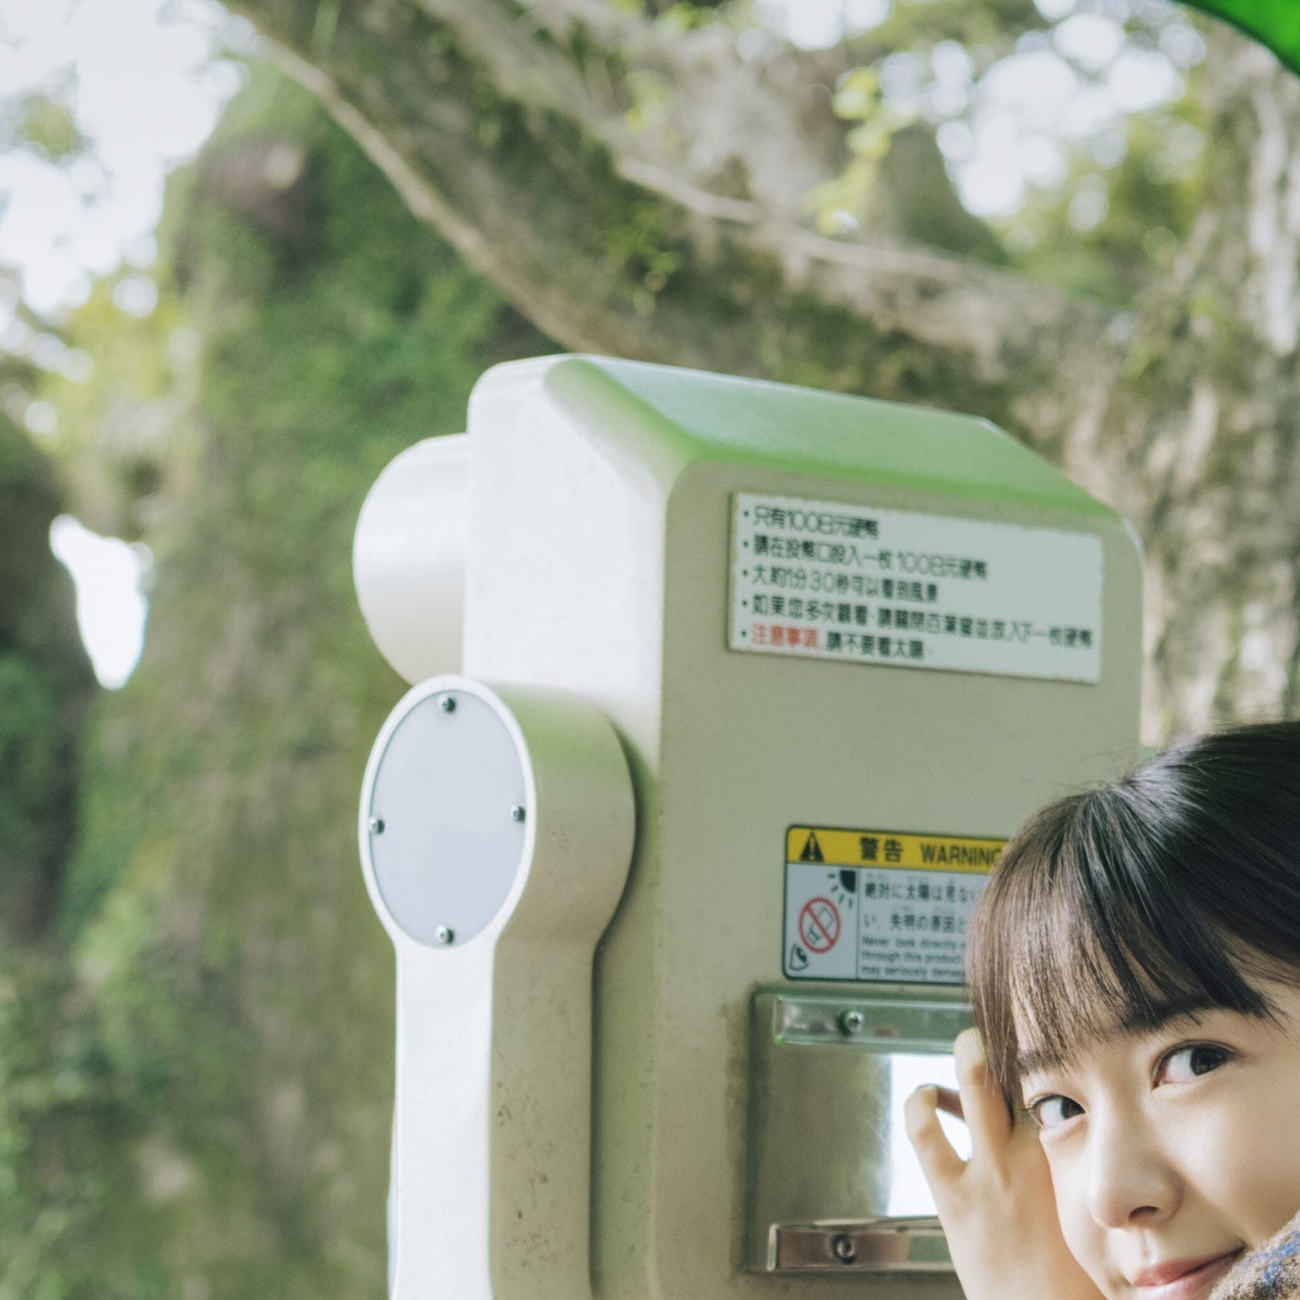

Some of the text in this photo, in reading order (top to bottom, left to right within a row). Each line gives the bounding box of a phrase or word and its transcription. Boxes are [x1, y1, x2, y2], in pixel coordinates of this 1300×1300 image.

[859, 836, 904, 863] 警告
[862, 936, 889, 946] Never
[895, 938, 916, 947] look
[921, 938, 956, 951] directly
[862, 951, 900, 964] through
[904, 952, 921, 961] this
[861, 967, 880, 977] may
[884, 968, 926, 979] seriously
